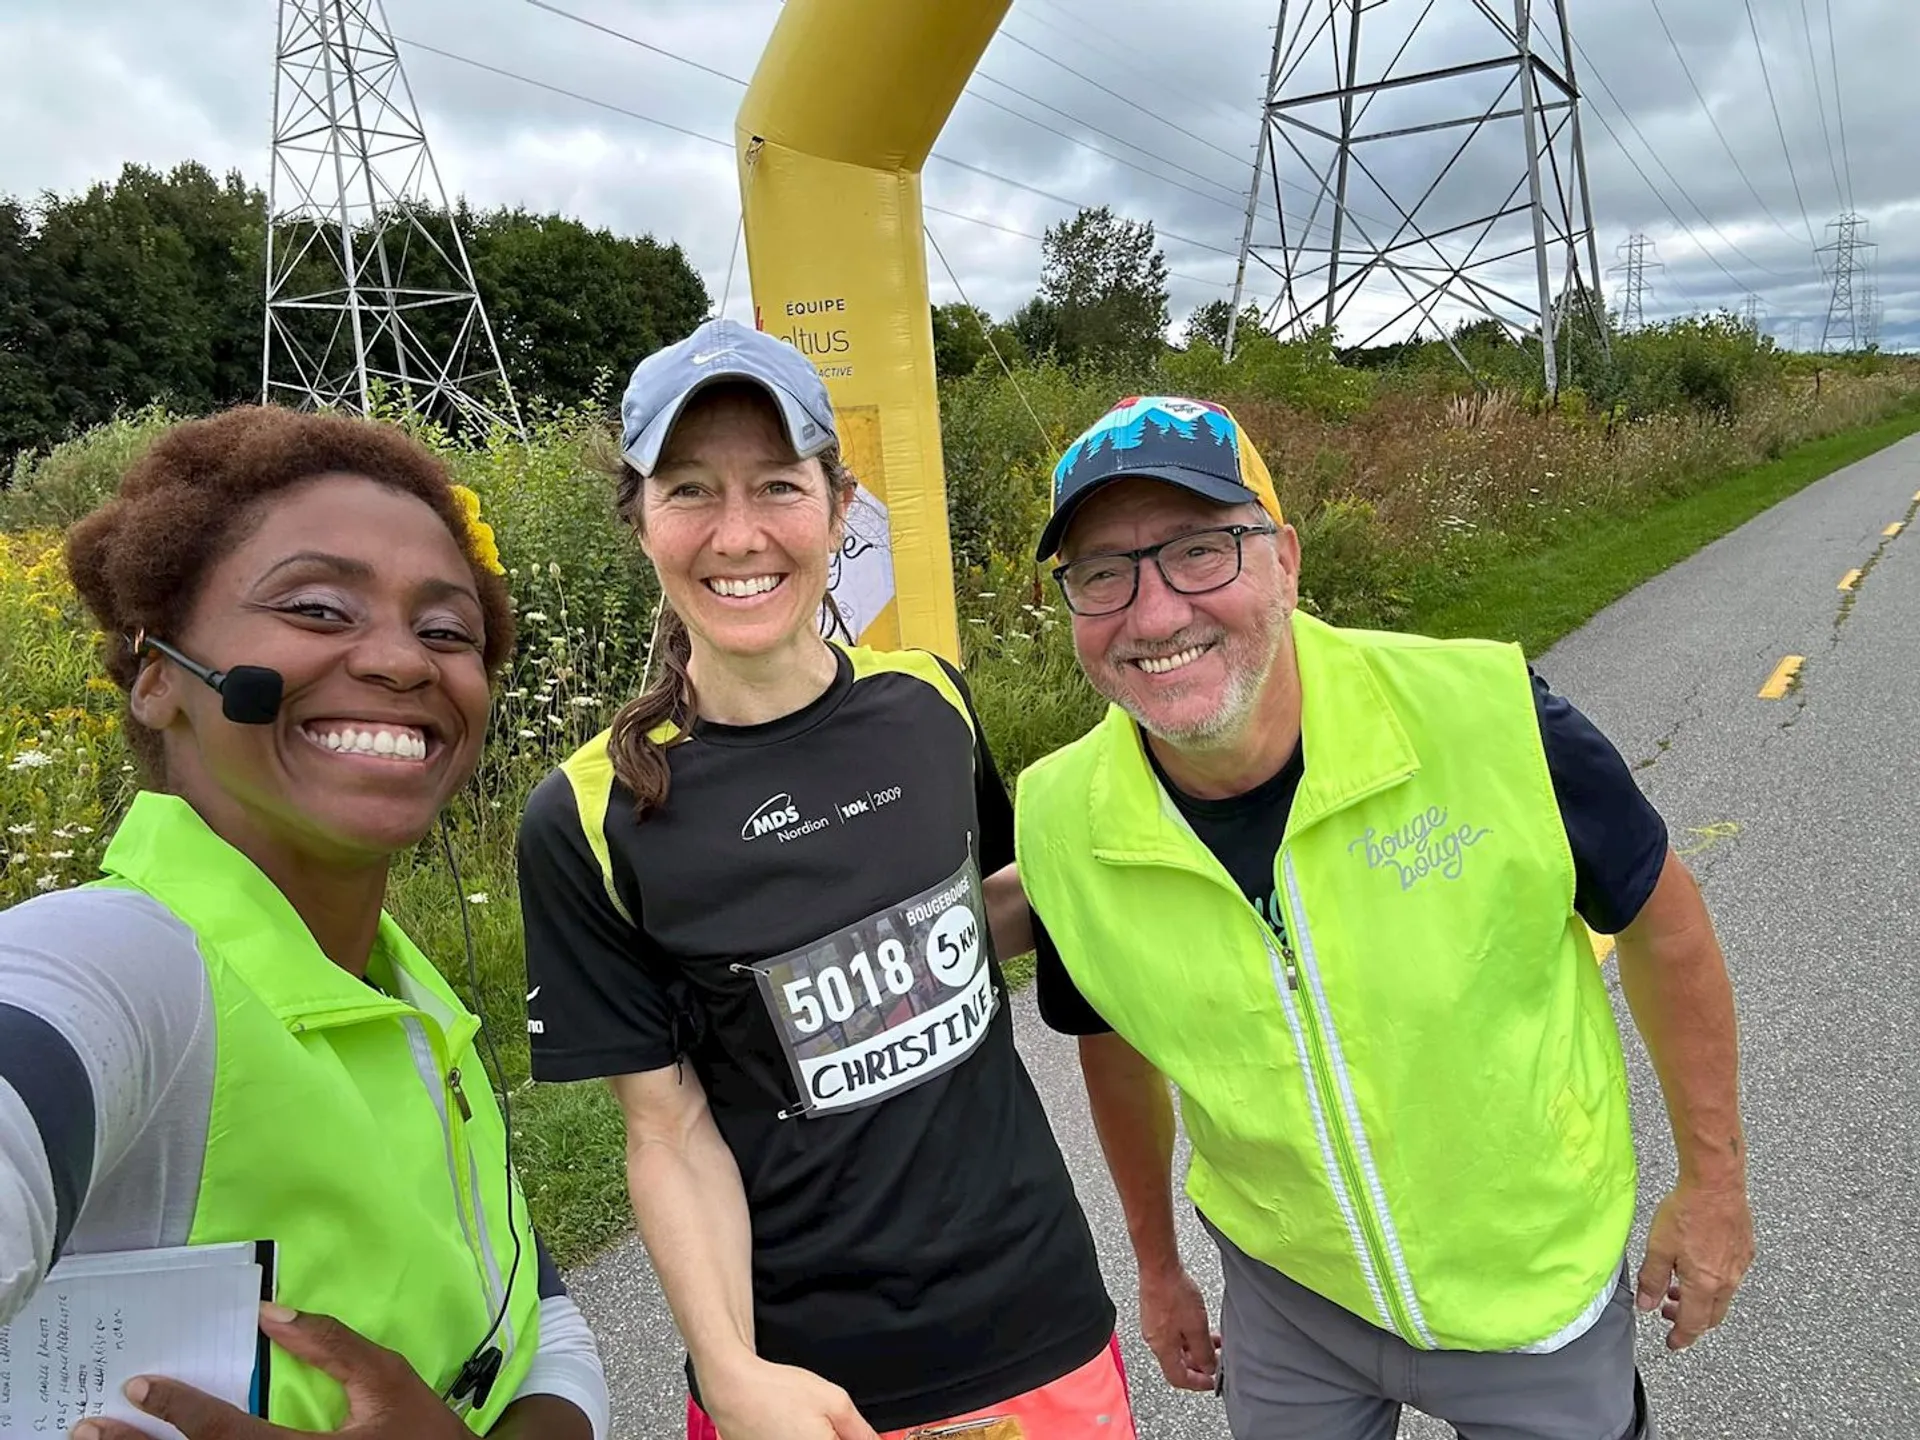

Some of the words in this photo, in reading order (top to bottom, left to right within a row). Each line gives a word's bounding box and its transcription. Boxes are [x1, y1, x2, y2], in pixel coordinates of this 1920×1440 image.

[752, 805, 801, 837] MDS
[776, 816, 830, 843] Nordion
[873, 786, 903, 806] 2009
[1348, 805, 1448, 869] bouge
[1382, 824, 1494, 891] bouge
[905, 877, 970, 927] BOUGEBOUGE
[937, 932, 960, 970] 5
[959, 920, 977, 953] KM
[782, 938, 915, 1034] 5018
[812, 983, 988, 1099] CHRISTINE
